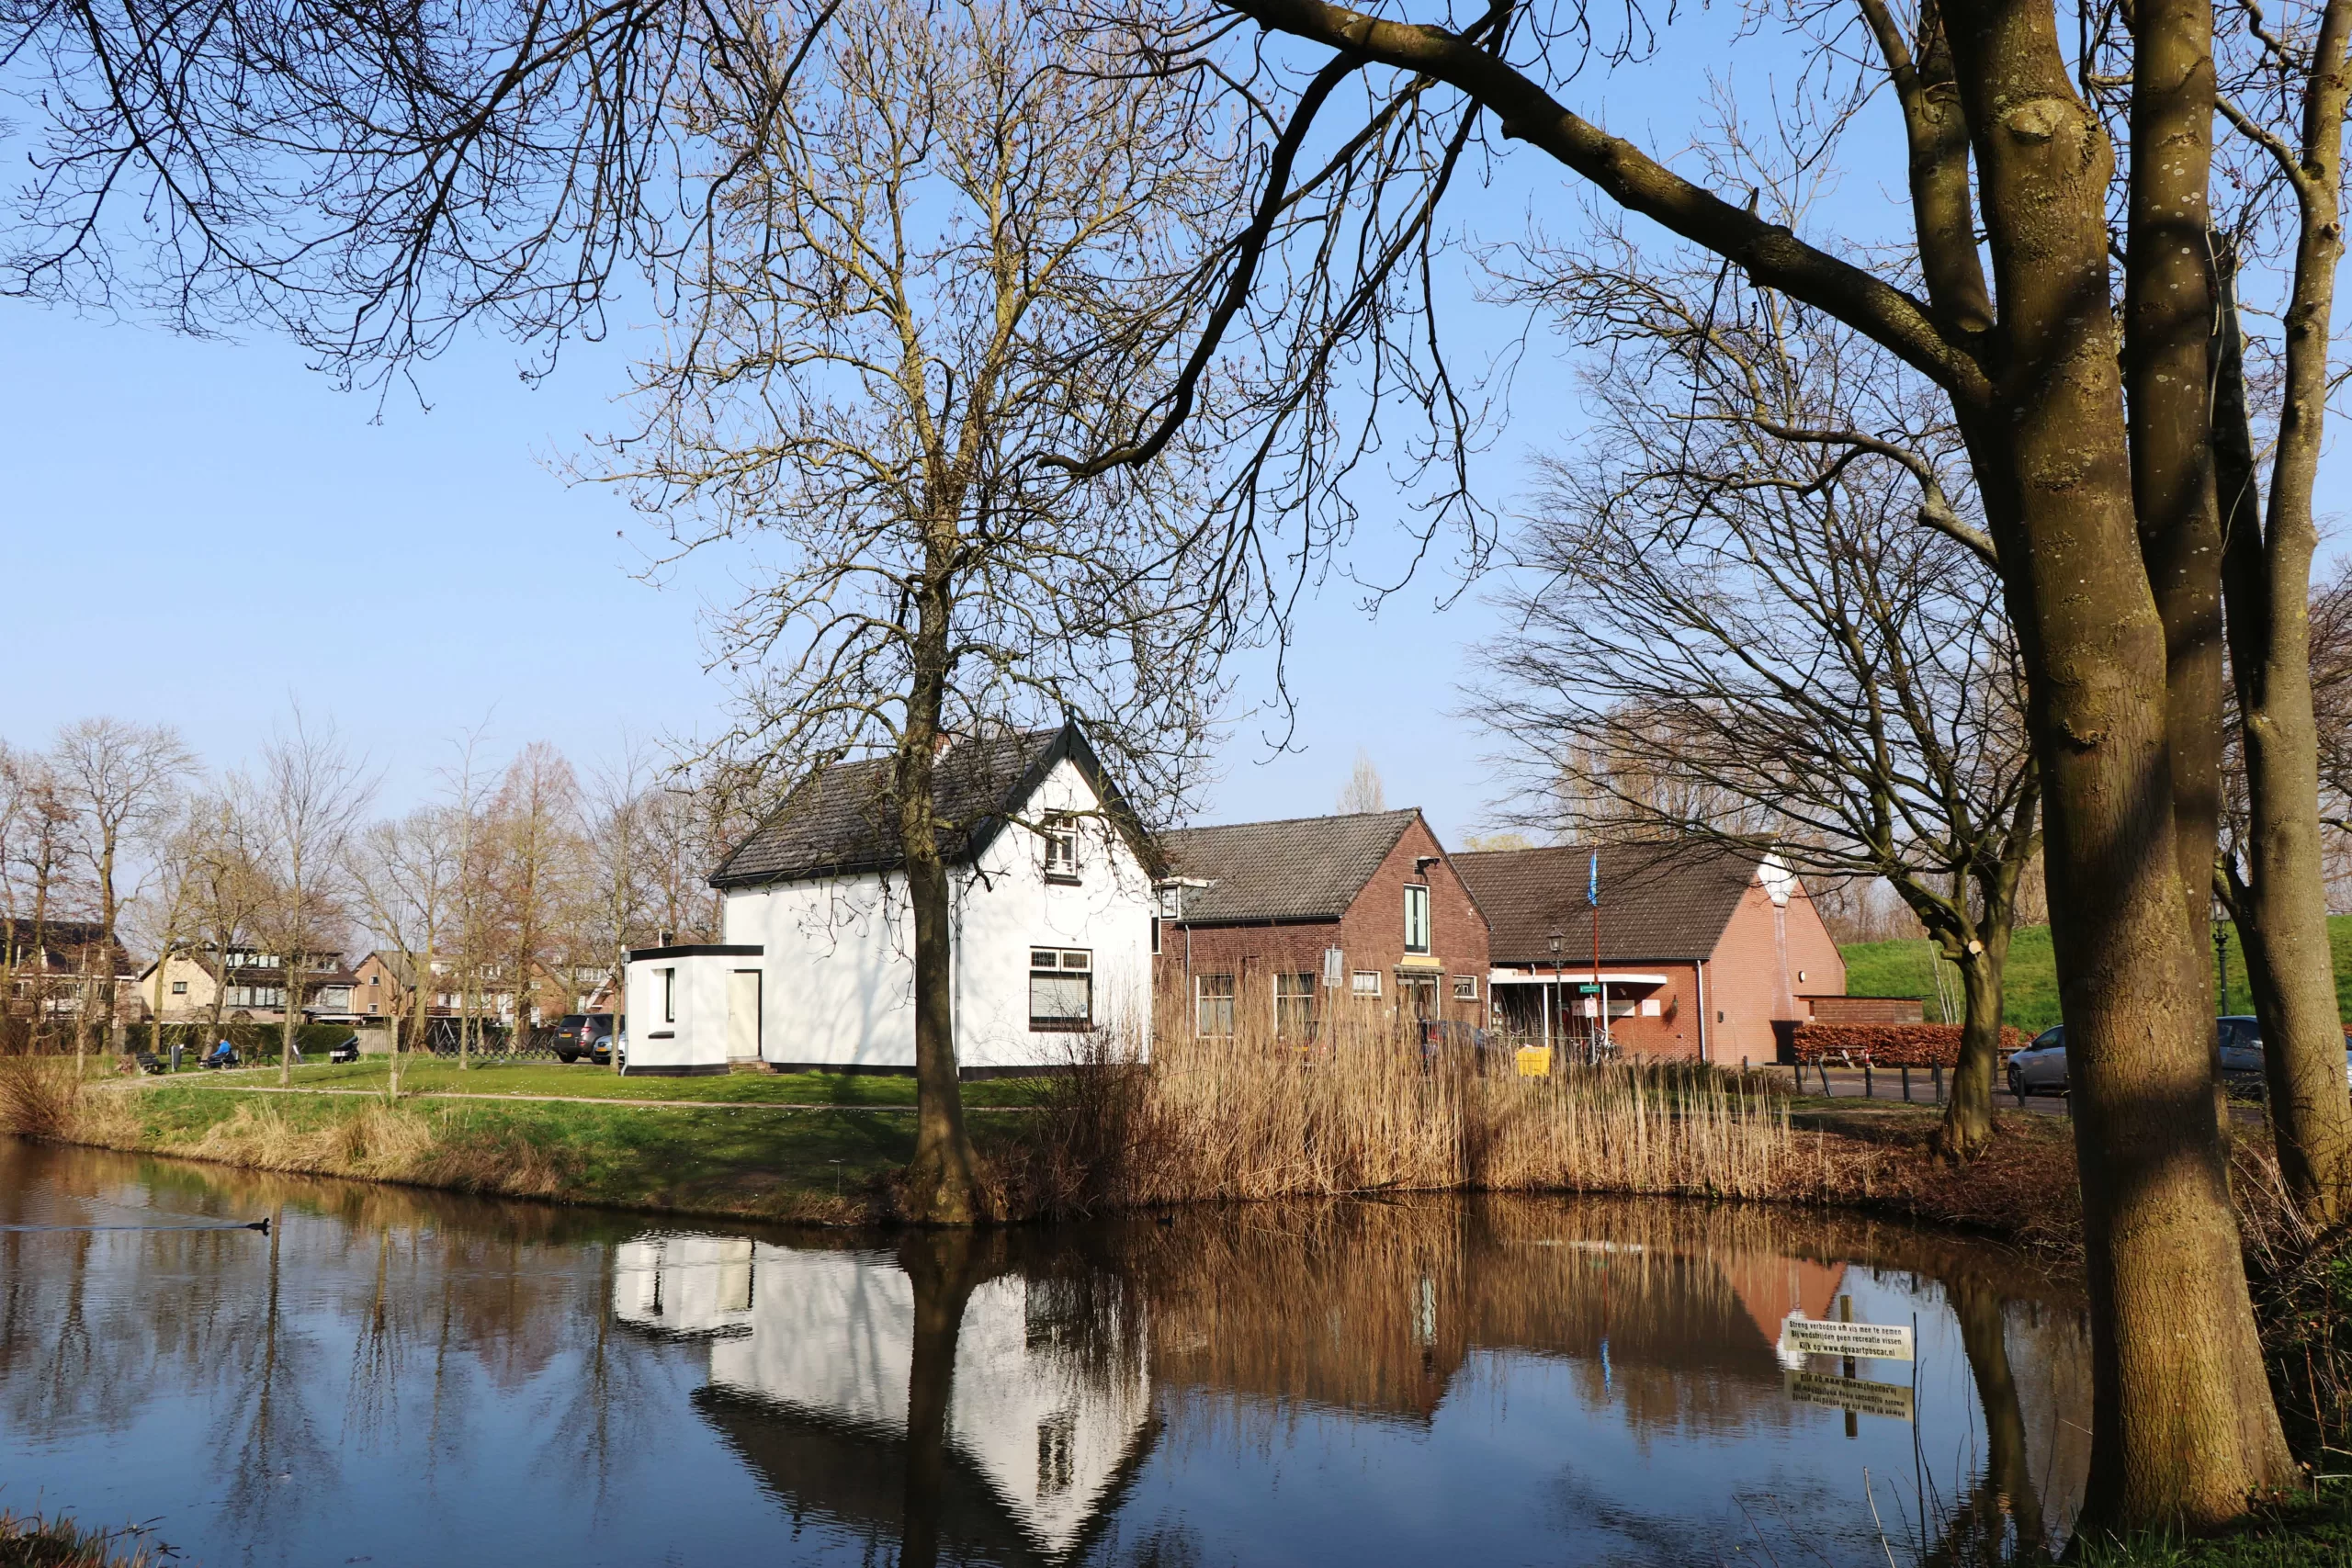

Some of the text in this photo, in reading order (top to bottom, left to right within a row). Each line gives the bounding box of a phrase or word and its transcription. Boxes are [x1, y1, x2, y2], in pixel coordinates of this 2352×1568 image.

[1789, 1320, 1808, 1330] Streng
[1791, 1330, 1799, 1338] Bij
[1800, 1331, 1834, 1341] wedstrijden
[1799, 1342, 1811, 1351] Kijk
